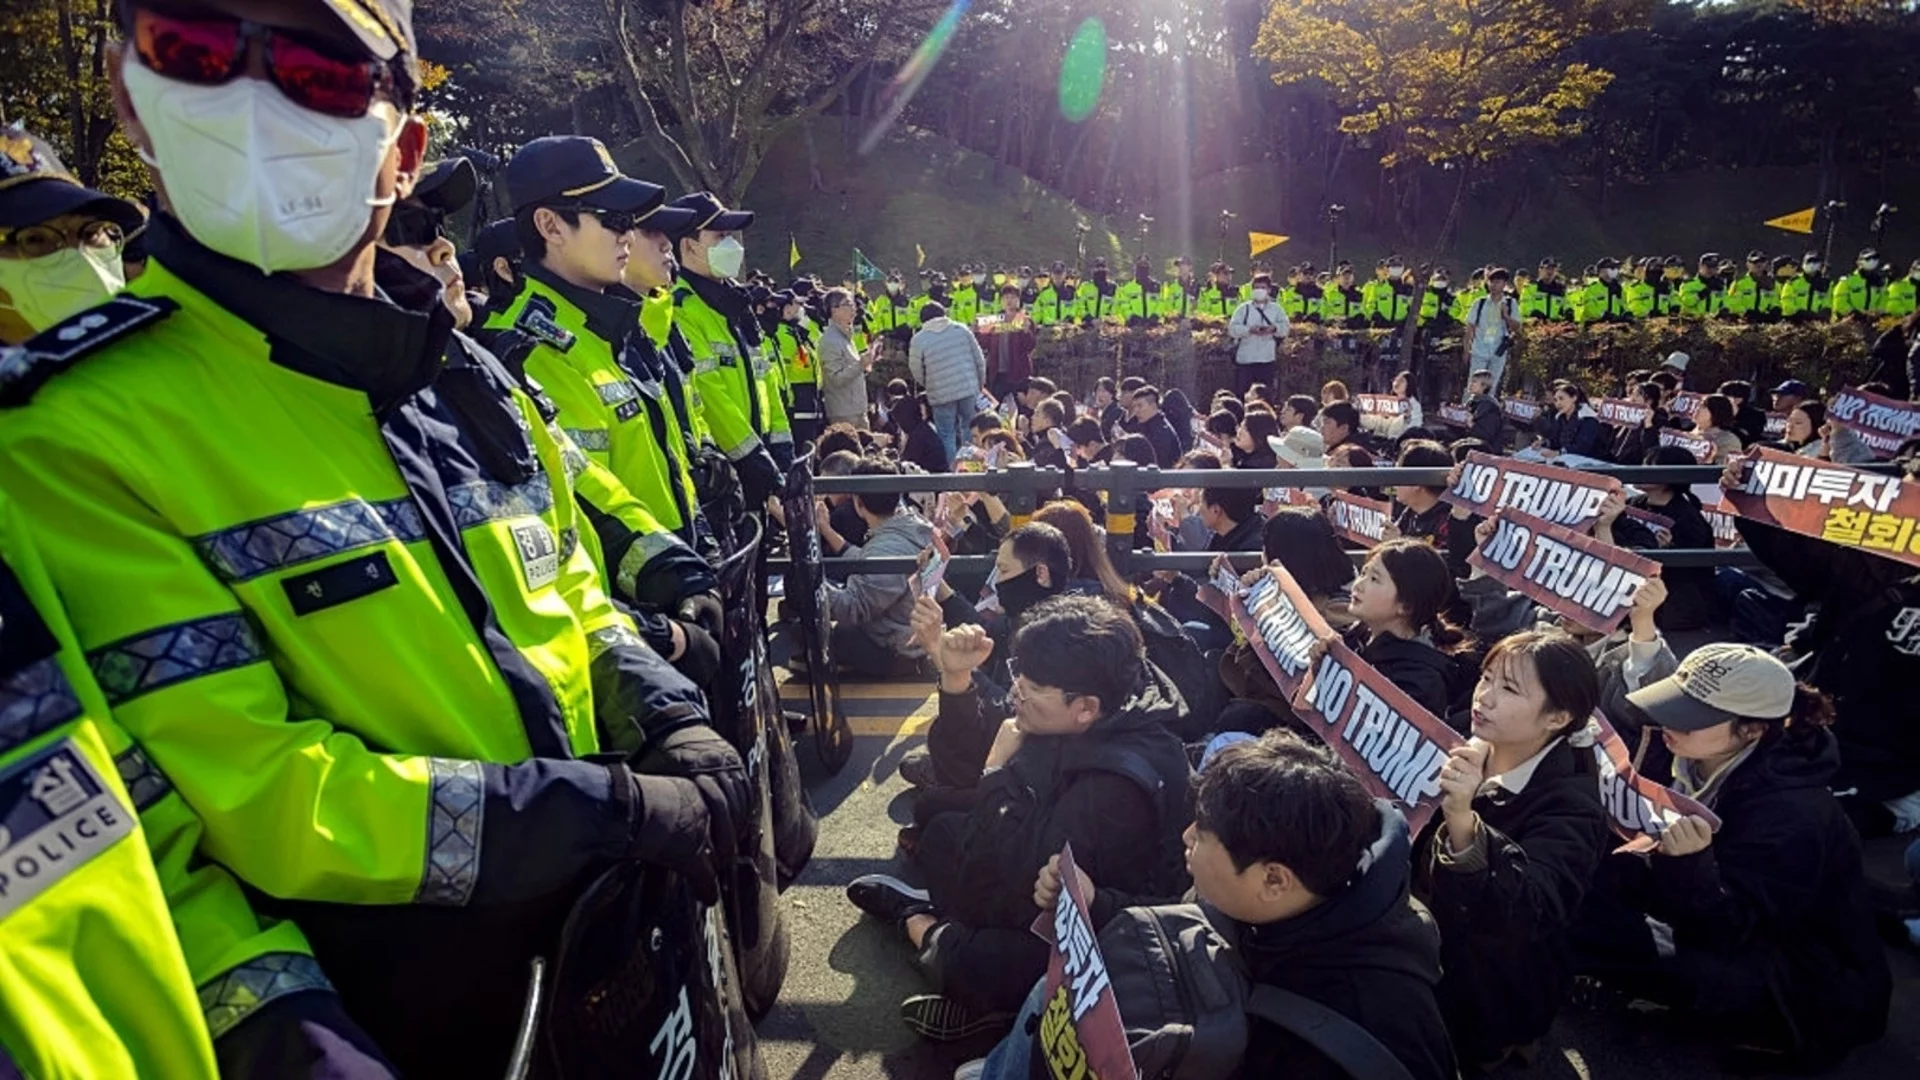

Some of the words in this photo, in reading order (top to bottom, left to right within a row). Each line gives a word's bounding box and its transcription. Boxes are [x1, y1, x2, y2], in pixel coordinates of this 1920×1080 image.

[1830, 394, 1866, 420] NO
[1453, 463, 1498, 504] NO
[1497, 471, 1608, 525] TRUMP
[1482, 519, 1531, 570] NO
[1523, 534, 1647, 618] TRUMP
[1256, 593, 1319, 677] TRUMP
[1314, 655, 1354, 724] NO
[1342, 684, 1450, 808] TRUMP
